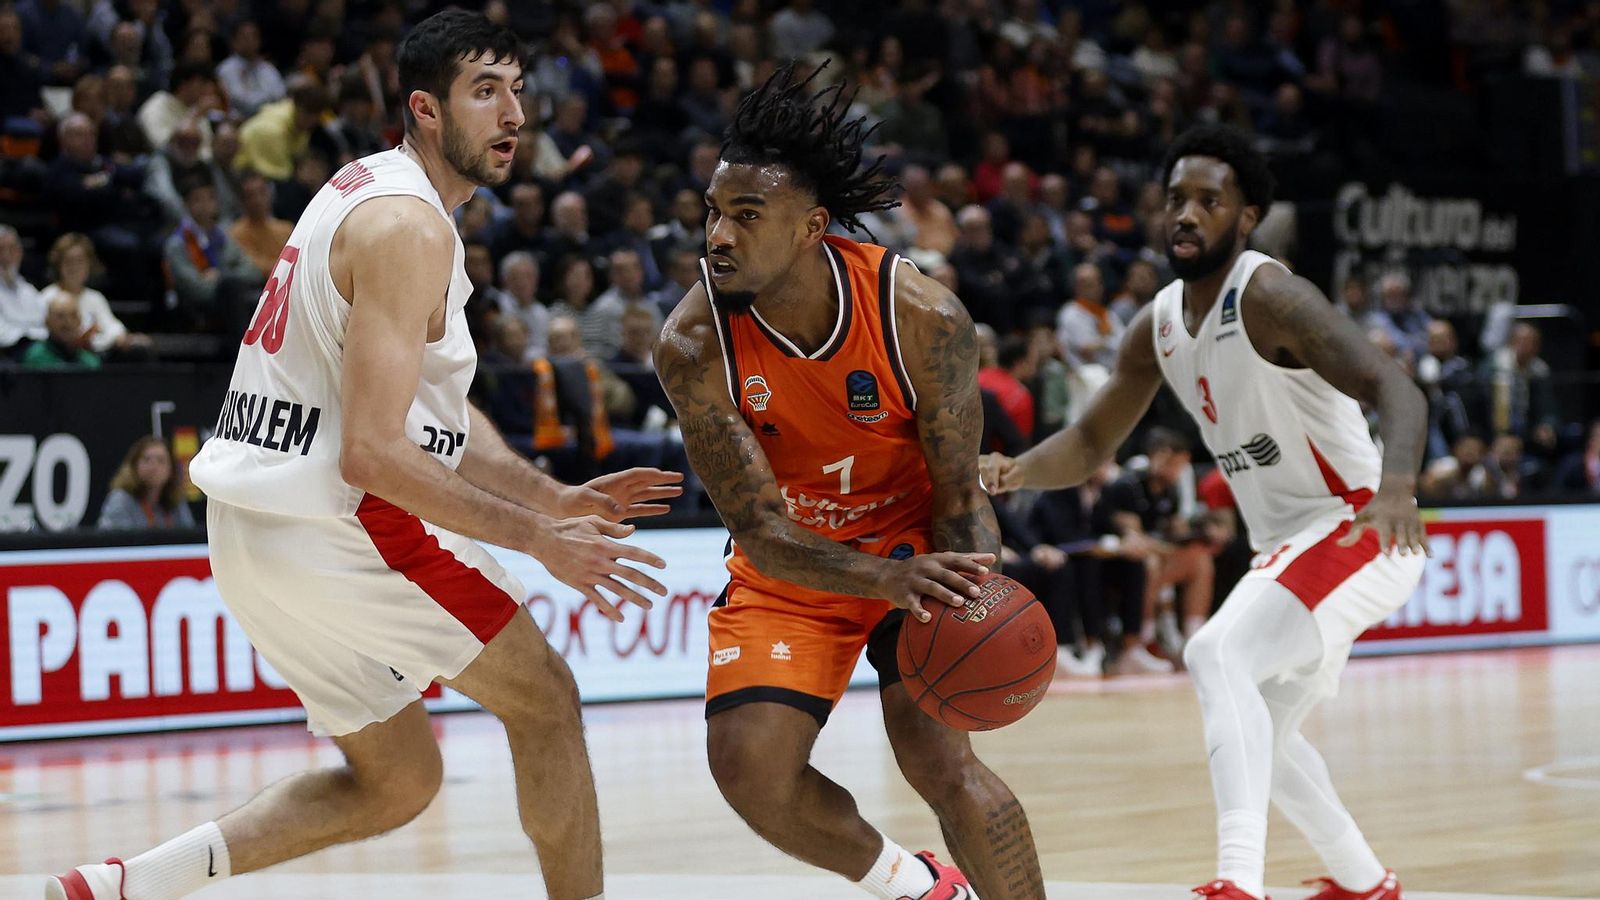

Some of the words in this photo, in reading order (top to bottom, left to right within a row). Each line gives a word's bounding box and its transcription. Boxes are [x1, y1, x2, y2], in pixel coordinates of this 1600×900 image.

[1198, 375, 1217, 424] 3
[822, 455, 855, 495] 7
[1384, 529, 1522, 629] ESA
[7, 575, 292, 706] PAM
